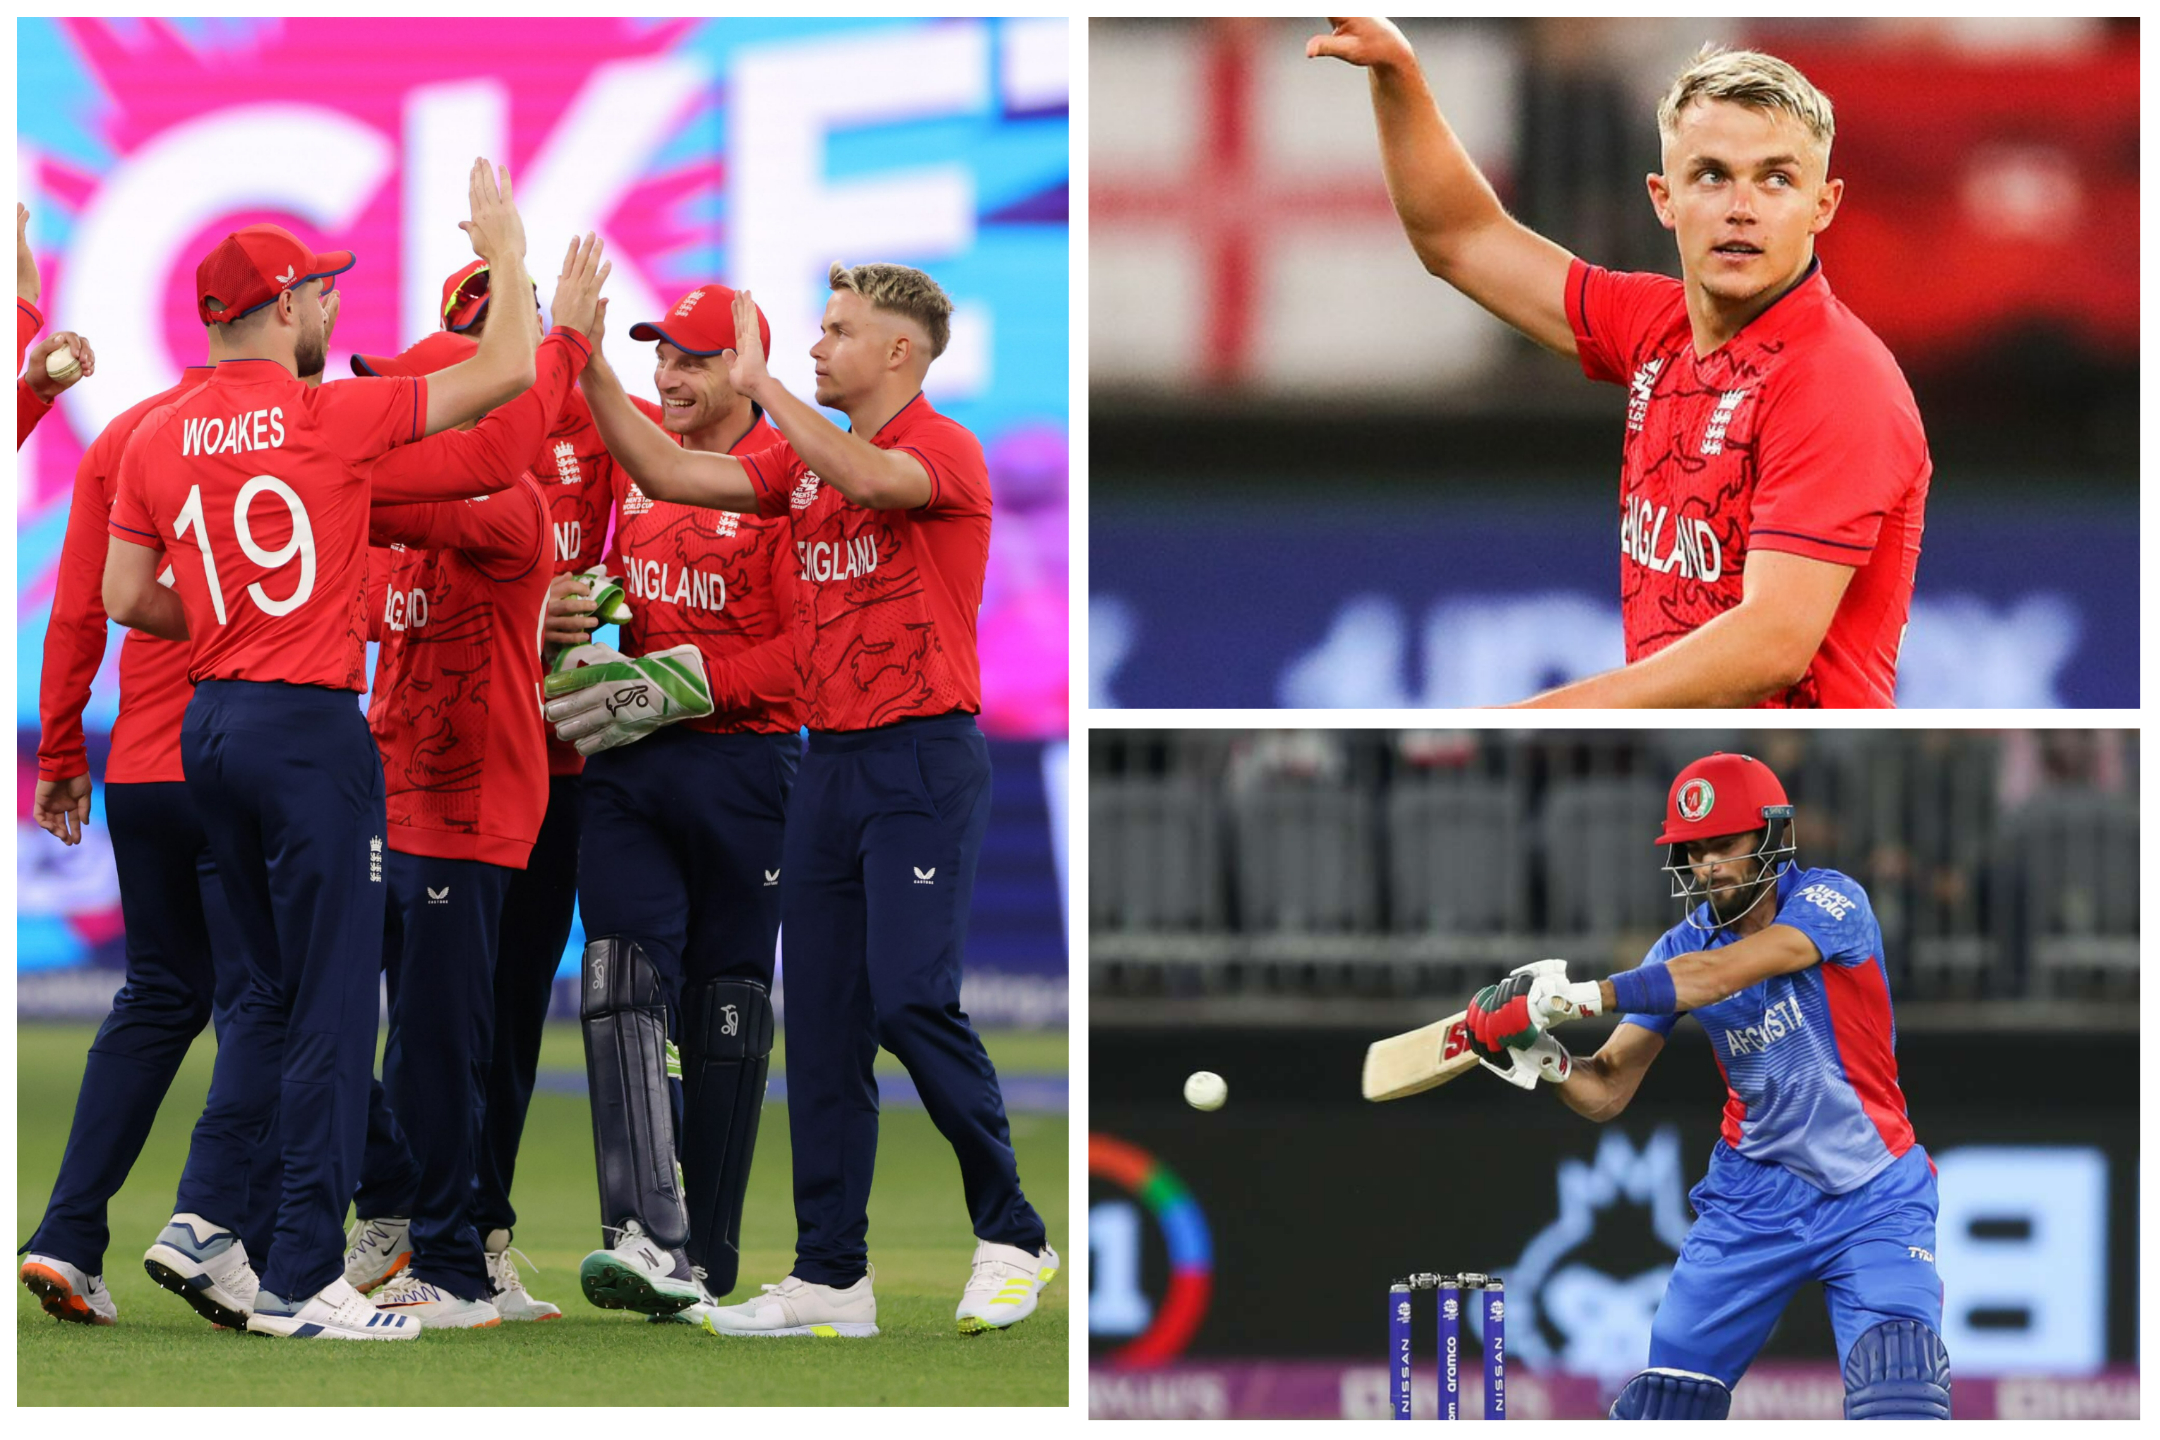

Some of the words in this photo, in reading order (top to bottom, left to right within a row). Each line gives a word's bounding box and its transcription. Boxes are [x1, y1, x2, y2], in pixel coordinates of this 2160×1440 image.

[182, 406, 285, 456] WOAKES
[172, 474, 317, 625] 19
[1401, 1338, 1410, 1413] NISSAN
[1446, 1336, 1457, 1393] aramco
[1494, 1337, 1504, 1412] NISSAN
